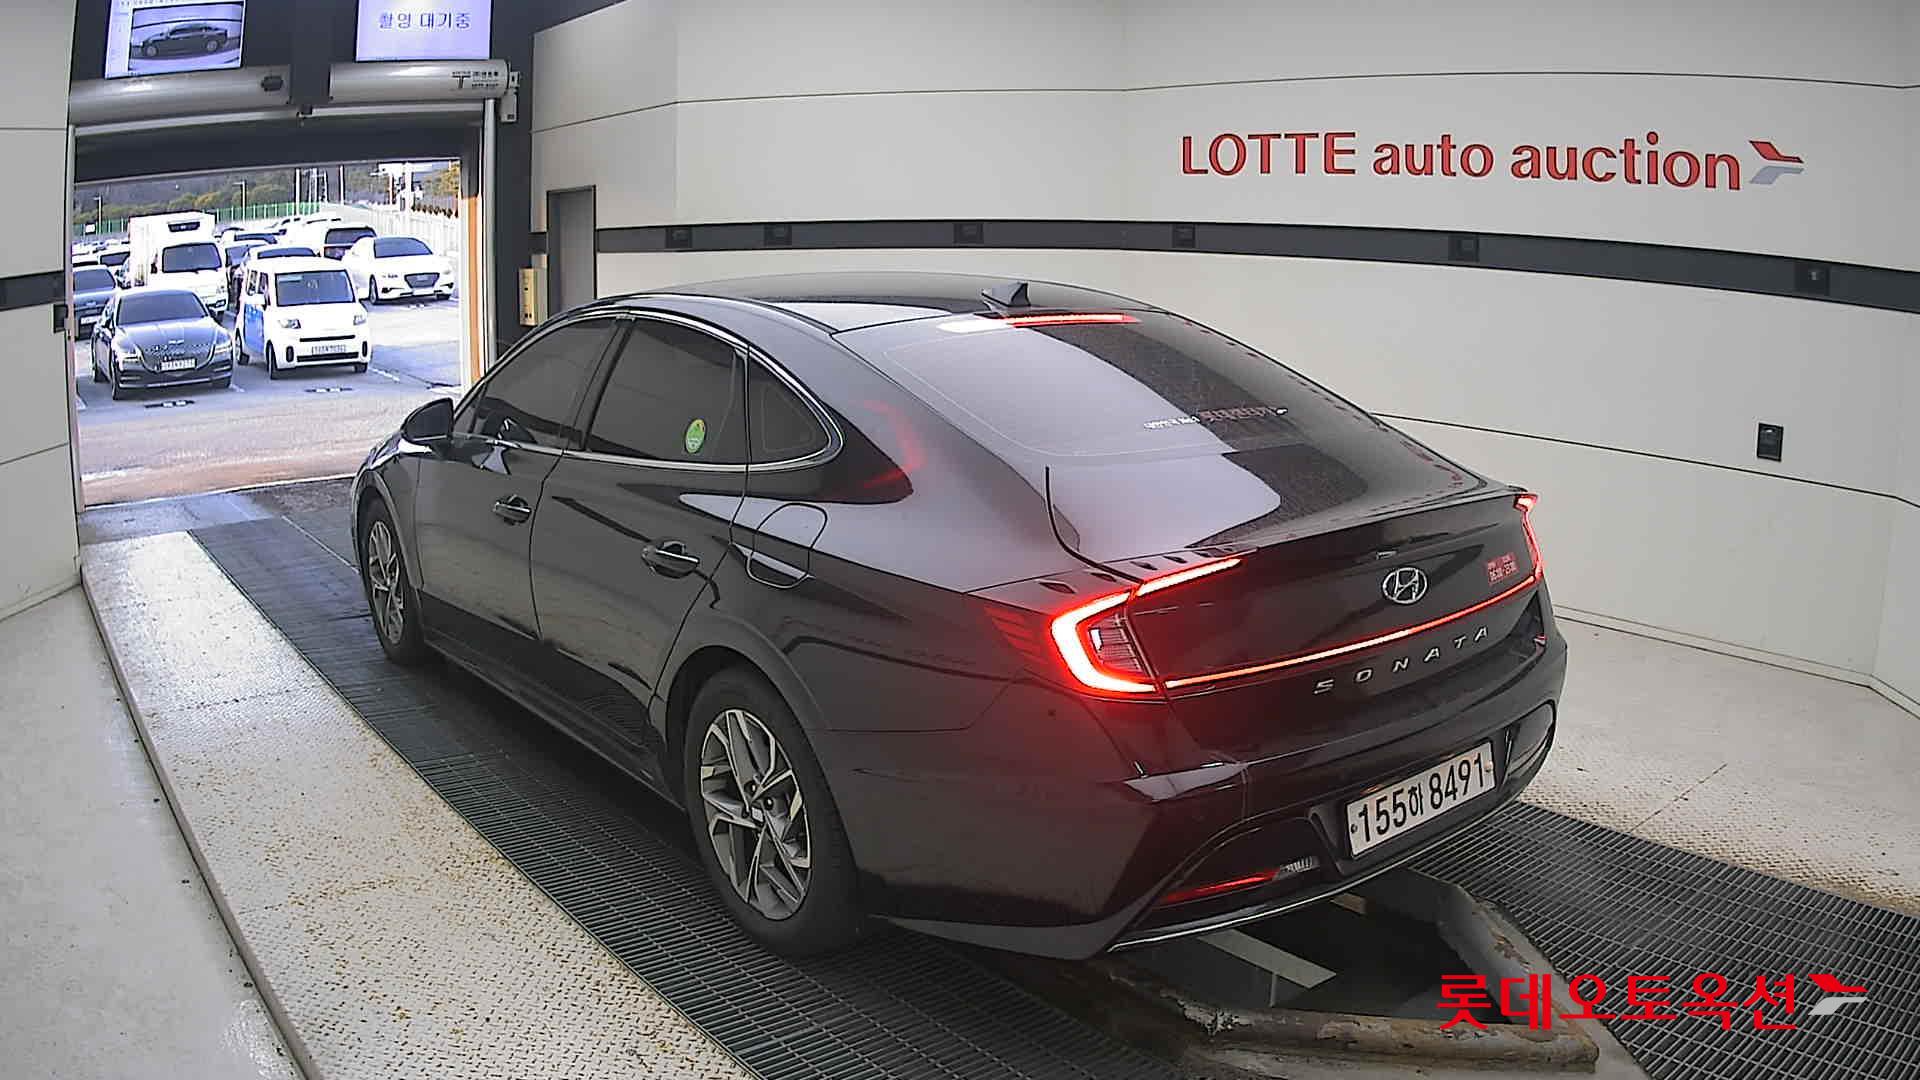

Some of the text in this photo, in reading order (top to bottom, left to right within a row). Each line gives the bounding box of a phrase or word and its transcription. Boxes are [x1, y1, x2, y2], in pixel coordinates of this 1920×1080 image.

[420, 12, 471, 29] 대기중
[1181, 131, 1742, 191] LOTTE auto auction
[1313, 626, 1489, 695] SONATA
[1429, 752, 1484, 810] 8491
